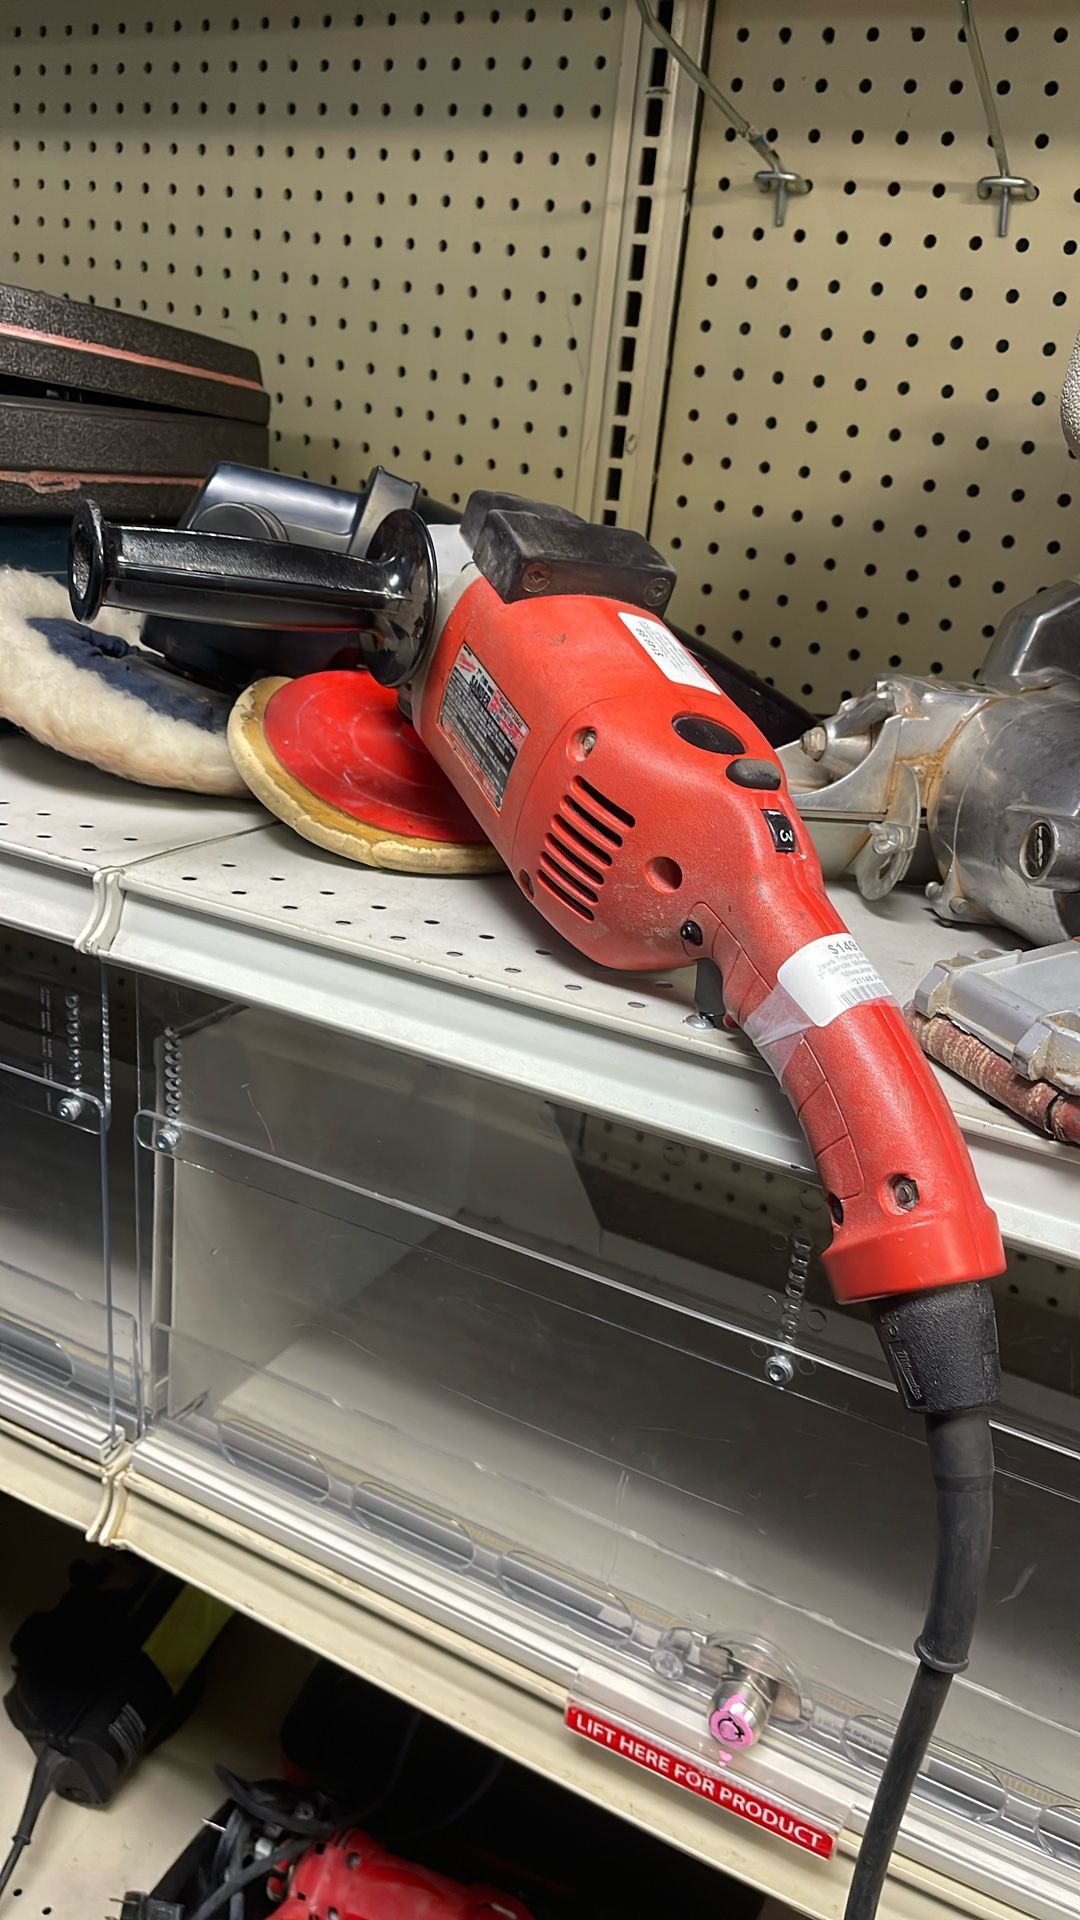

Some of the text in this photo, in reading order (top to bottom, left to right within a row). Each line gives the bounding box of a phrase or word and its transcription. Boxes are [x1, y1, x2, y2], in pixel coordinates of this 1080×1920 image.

[469, 674, 491, 709] SANDER
[779, 829, 793, 843] 3
[576, 1713, 824, 1849] LIFT HERE FOR PRODUCT
